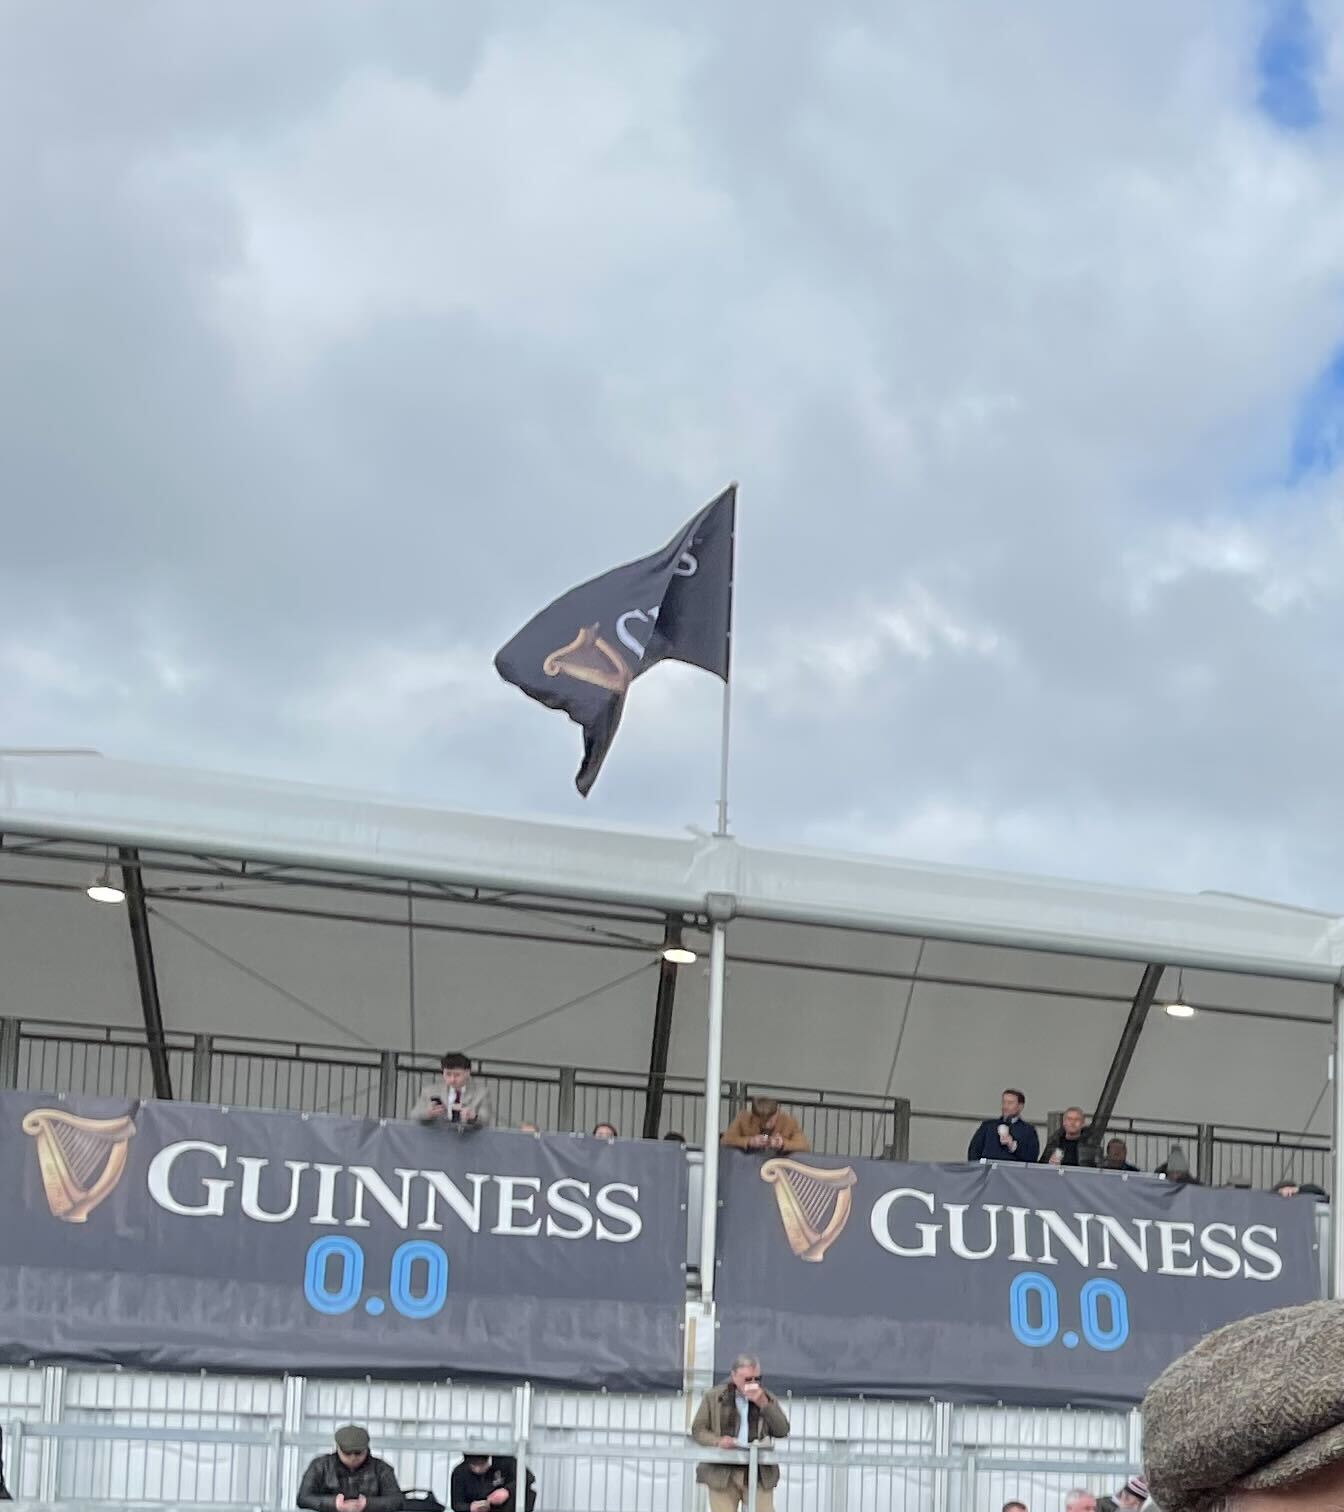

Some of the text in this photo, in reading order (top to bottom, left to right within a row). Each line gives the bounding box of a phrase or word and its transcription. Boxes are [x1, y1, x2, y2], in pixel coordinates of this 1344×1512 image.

[146, 1140, 644, 1244] GUINNESS
[869, 1187, 1284, 1283] GUINNESS
[303, 1233, 450, 1320] 0.0
[1009, 1270, 1131, 1353] 0.0
